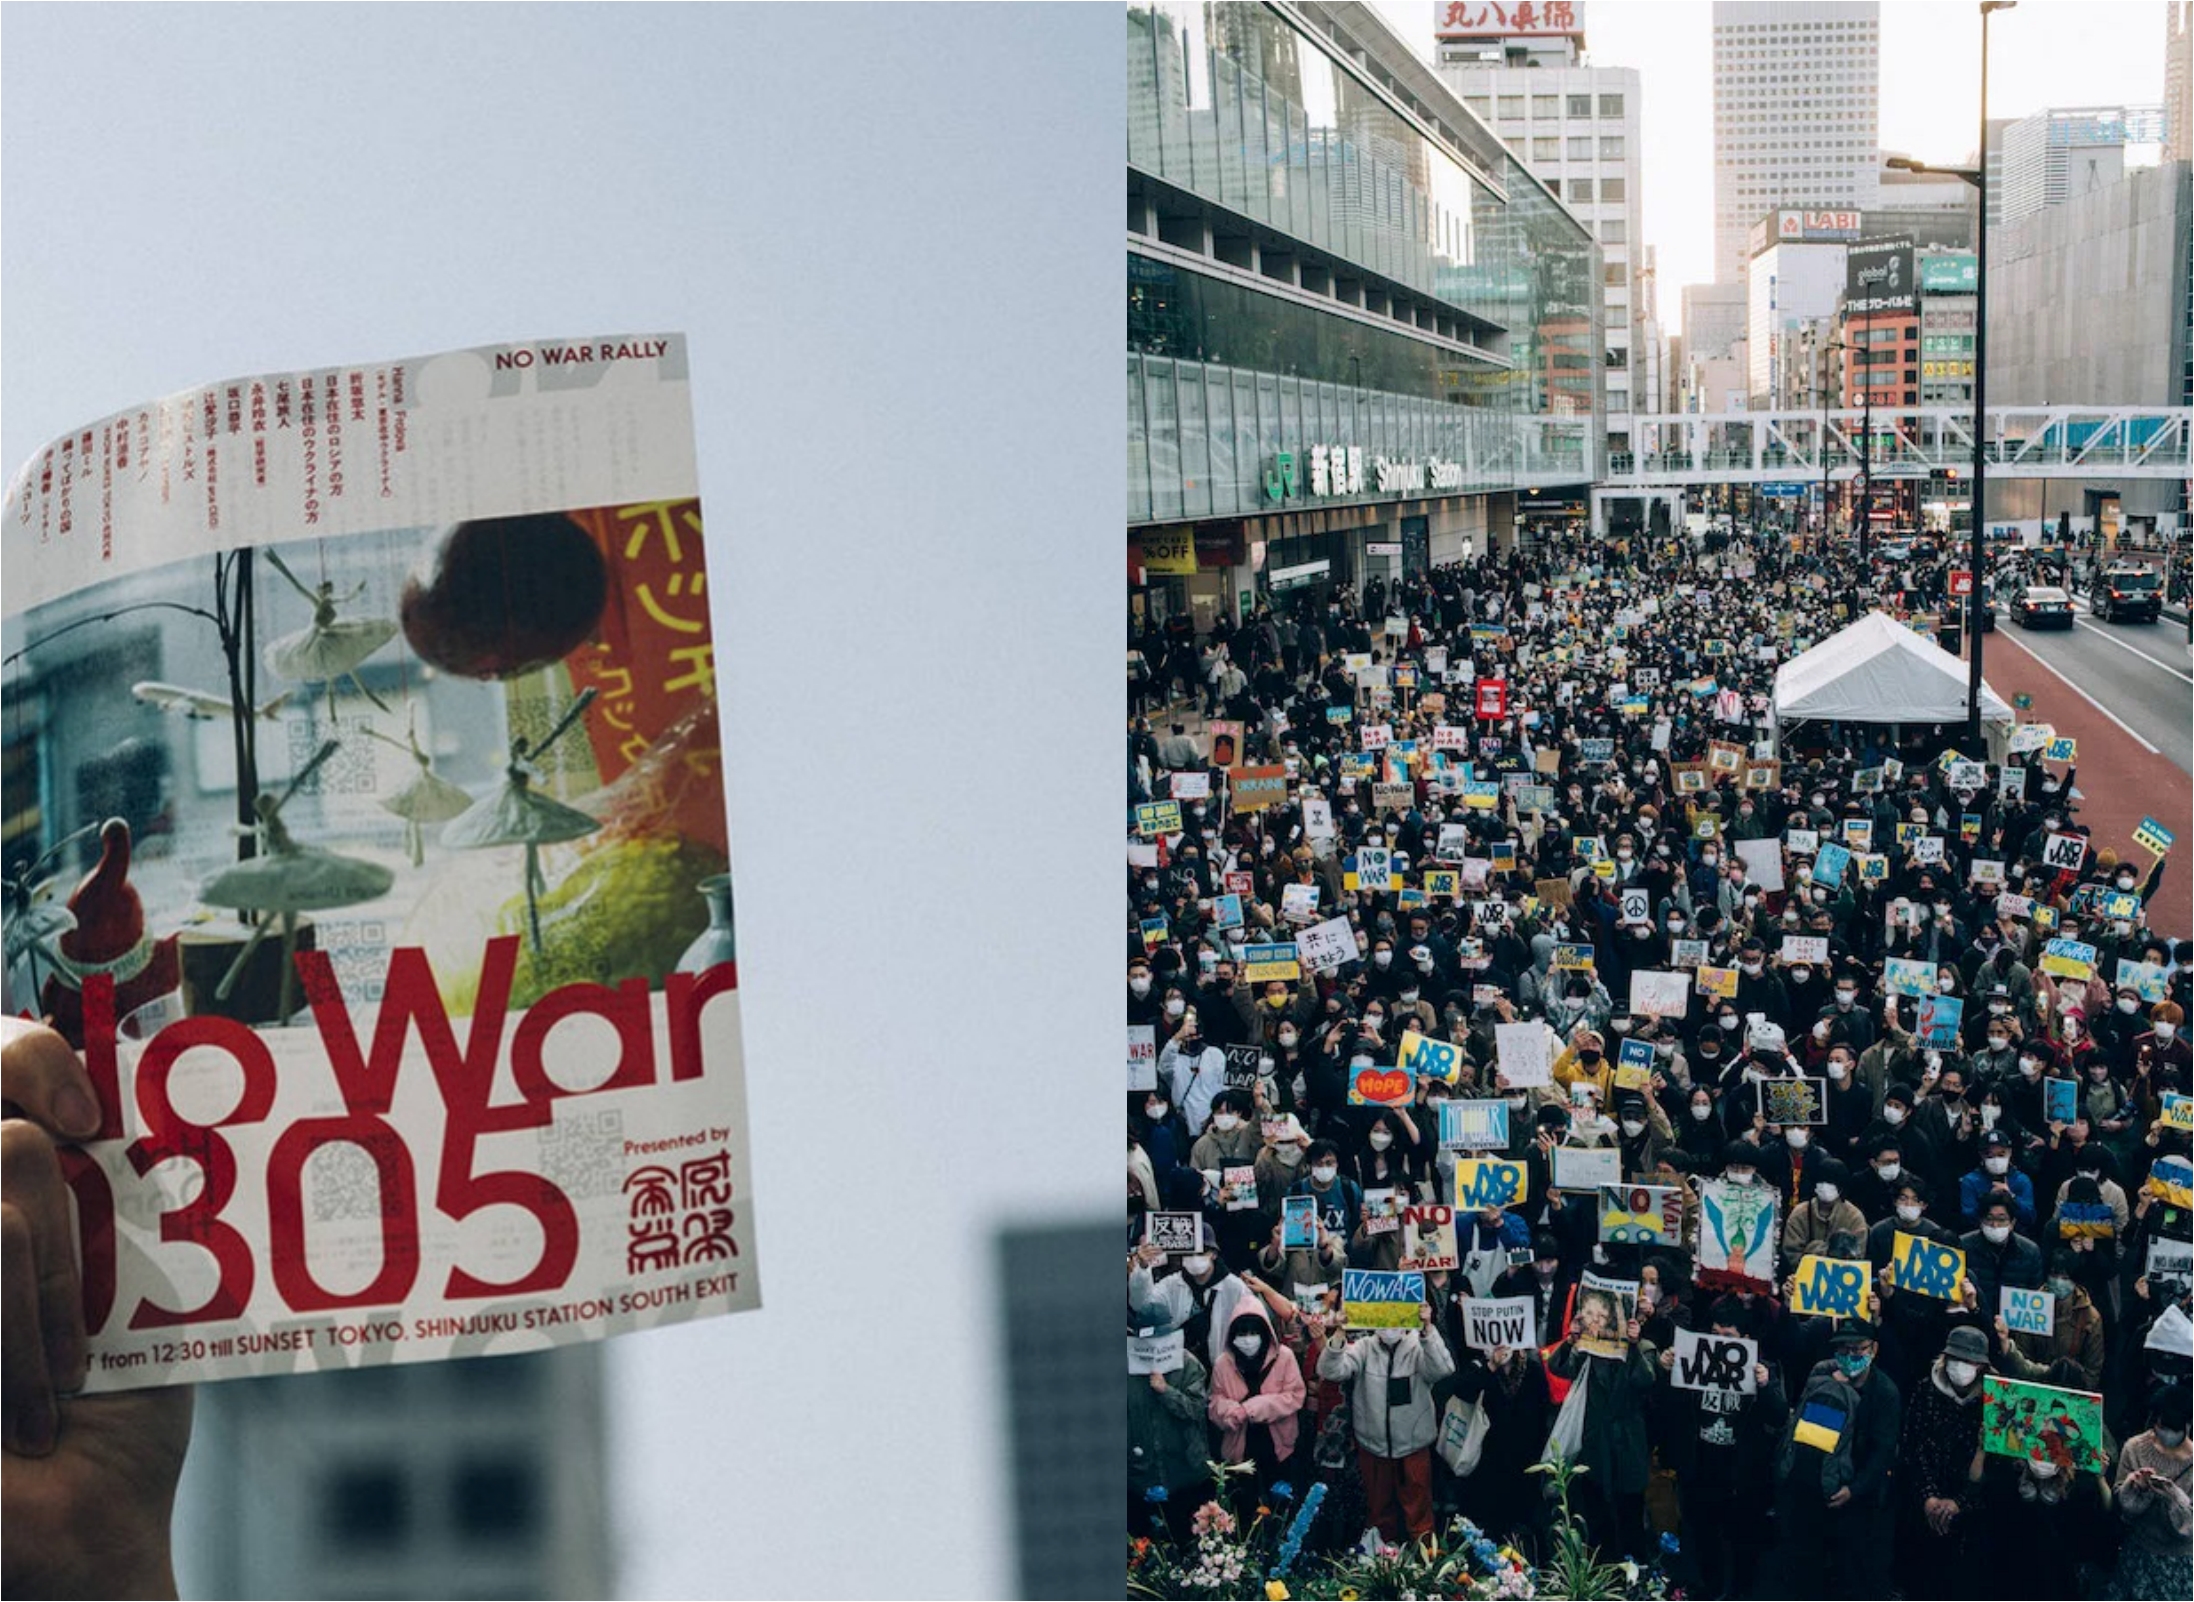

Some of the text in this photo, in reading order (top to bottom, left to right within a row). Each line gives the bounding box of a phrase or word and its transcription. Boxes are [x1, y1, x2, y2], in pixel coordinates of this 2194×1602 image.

[1805, 212, 1857, 229] LABI
[495, 340, 668, 370] NO WAR RALLY
[301, 377, 320, 525] 日本在住のウクライナの方
[1267, 451, 1297, 501] JR
[1311, 443, 1462, 497] 新宿駅 Shinjuku Station
[2054, 738, 2073, 751] NO
[2059, 839, 2083, 854] NO
[1359, 868, 1389, 885] WAR
[1483, 903, 1505, 914] NO
[1307, 946, 1346, 966] 生きよう
[1789, 938, 1823, 947] PEACE
[295, 935, 738, 1112] War
[1405, 1051, 1454, 1078] WAR
[1416, 1038, 1456, 1066] NO
[1628, 1045, 1645, 1058] NO
[1360, 1076, 1404, 1096] HOPE
[623, 1127, 731, 1156] Presented by
[1476, 1162, 1520, 1188] NO
[1462, 1181, 1517, 1209] WAR
[1602, 1186, 1651, 1214] NO
[1155, 1216, 1194, 1236] 反戦
[1404, 1205, 1451, 1226] NO
[1661, 1191, 1683, 1239] War
[1910, 1238, 1961, 1277] NO
[1813, 1260, 1863, 1290] NO
[1894, 1257, 1957, 1302] WAR
[1471, 1304, 1525, 1318] STOP PUTIN
[1799, 1281, 1860, 1319] WAR
[2010, 1291, 2045, 1311] NO
[101, 1351, 147, 1371] from
[152, 1340, 204, 1363] 12:30
[211, 1337, 233, 1358] till
[236, 1329, 315, 1355] SUNSET
[415, 1313, 517, 1340] SHINJUKU
[524, 1298, 614, 1329] STATION
[621, 1281, 690, 1314] SOUTH
[695, 1272, 738, 1299] EXIT
[1473, 1318, 1525, 1346] NOW
[2004, 1308, 2047, 1332] WAR
[1698, 1337, 1748, 1365] NO
[1680, 1356, 1745, 1392] WAR
